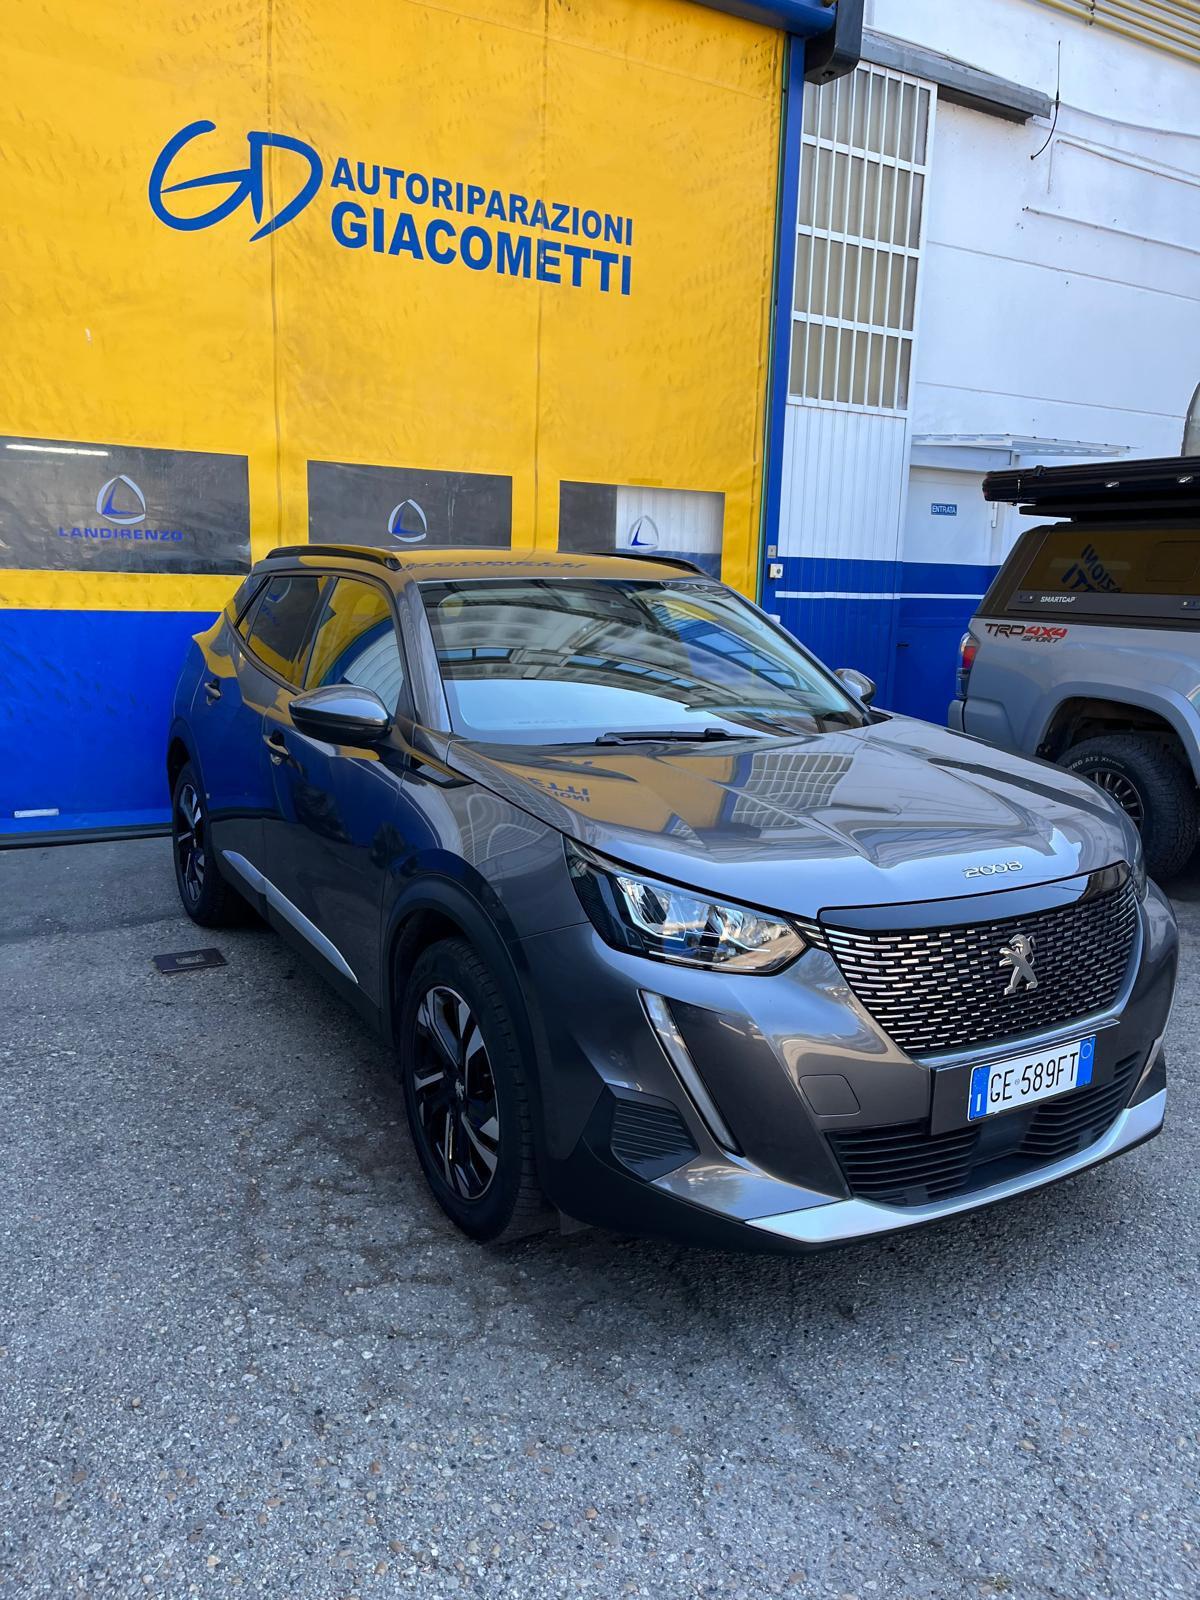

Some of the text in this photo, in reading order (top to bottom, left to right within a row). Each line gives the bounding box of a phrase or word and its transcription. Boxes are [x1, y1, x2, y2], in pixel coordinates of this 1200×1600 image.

[331, 157, 632, 245] AUTORIPARAZIONI
[331, 201, 631, 295] GIACOMETTI
[932, 505, 956, 514] ENTRATA
[58, 527, 183, 541] LANDIRENZO
[985, 623, 1025, 638] TRD
[1021, 635, 1061, 643] SPORT
[963, 861, 1022, 879] 2008
[990, 1069, 1014, 1102] GE
[1020, 1052, 1078, 1095] 589FT
